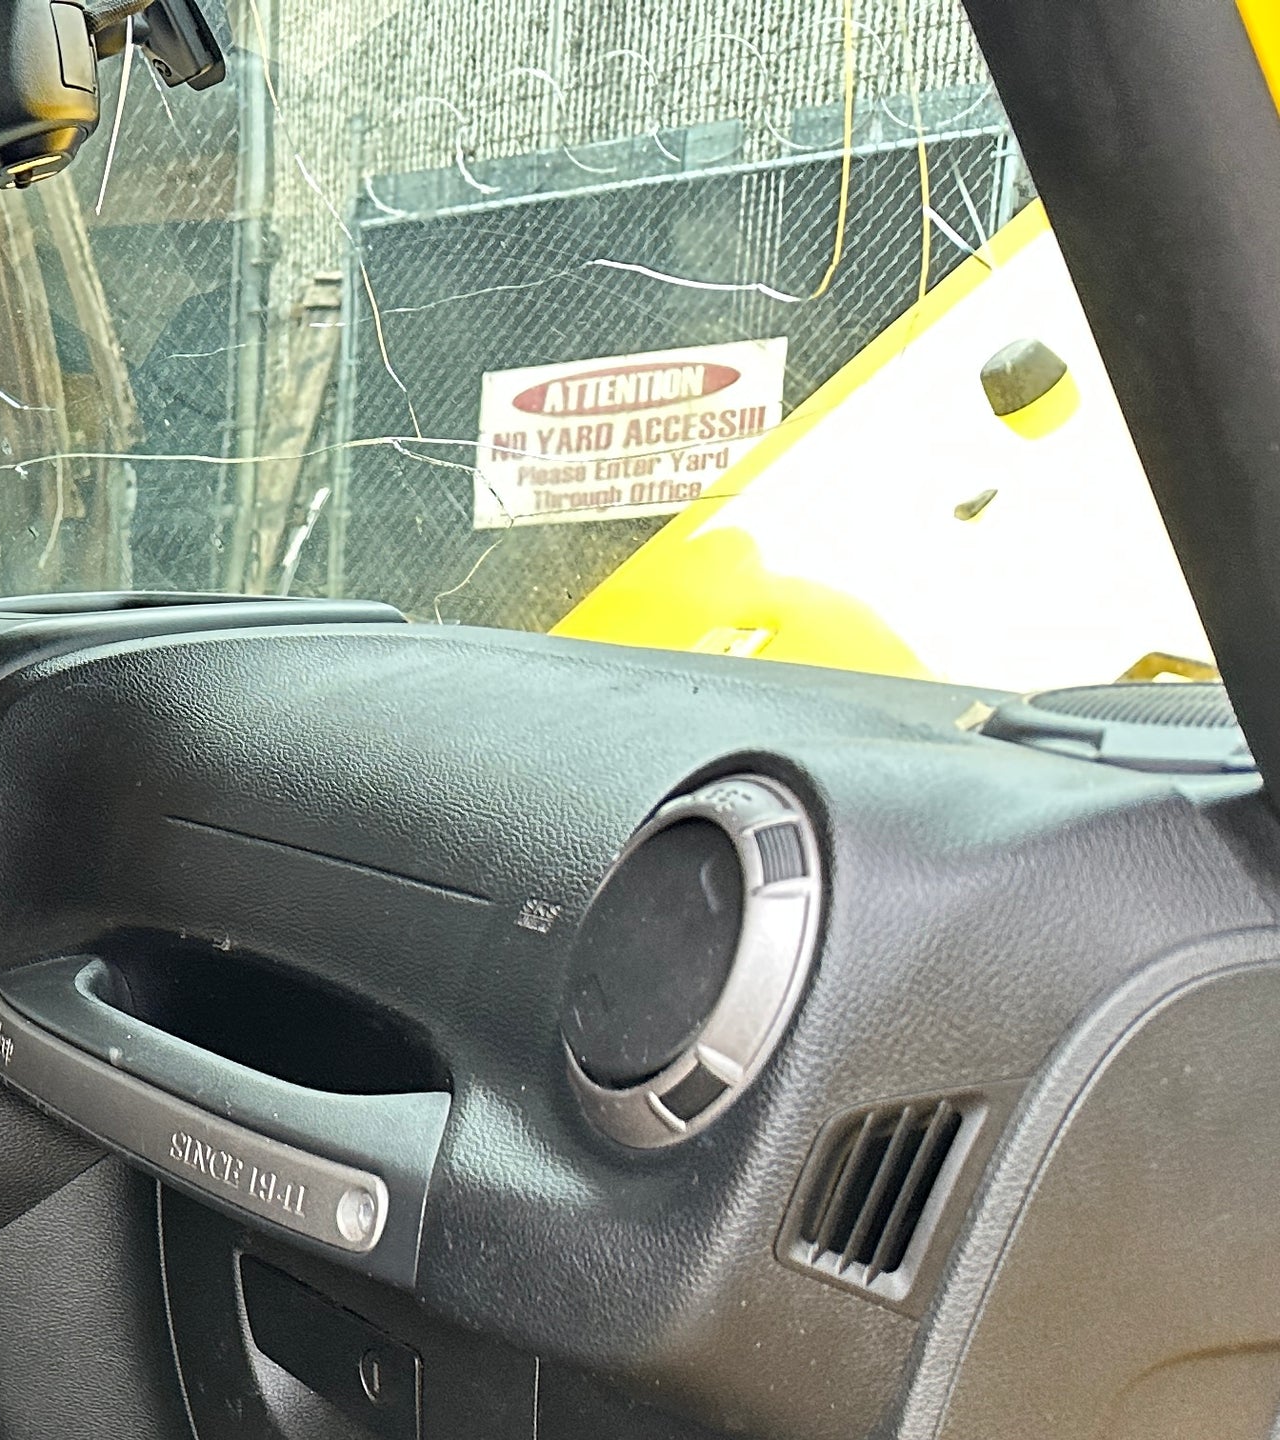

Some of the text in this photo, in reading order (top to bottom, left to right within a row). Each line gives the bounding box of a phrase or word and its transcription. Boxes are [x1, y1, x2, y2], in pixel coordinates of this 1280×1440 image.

[542, 364, 705, 413] ATTENTION
[491, 431, 528, 462] NO
[536, 422, 614, 456] YARD
[517, 447, 729, 487] Please Enter Yard
[532, 481, 703, 513] Through Office
[169, 1131, 244, 1190] SINCE
